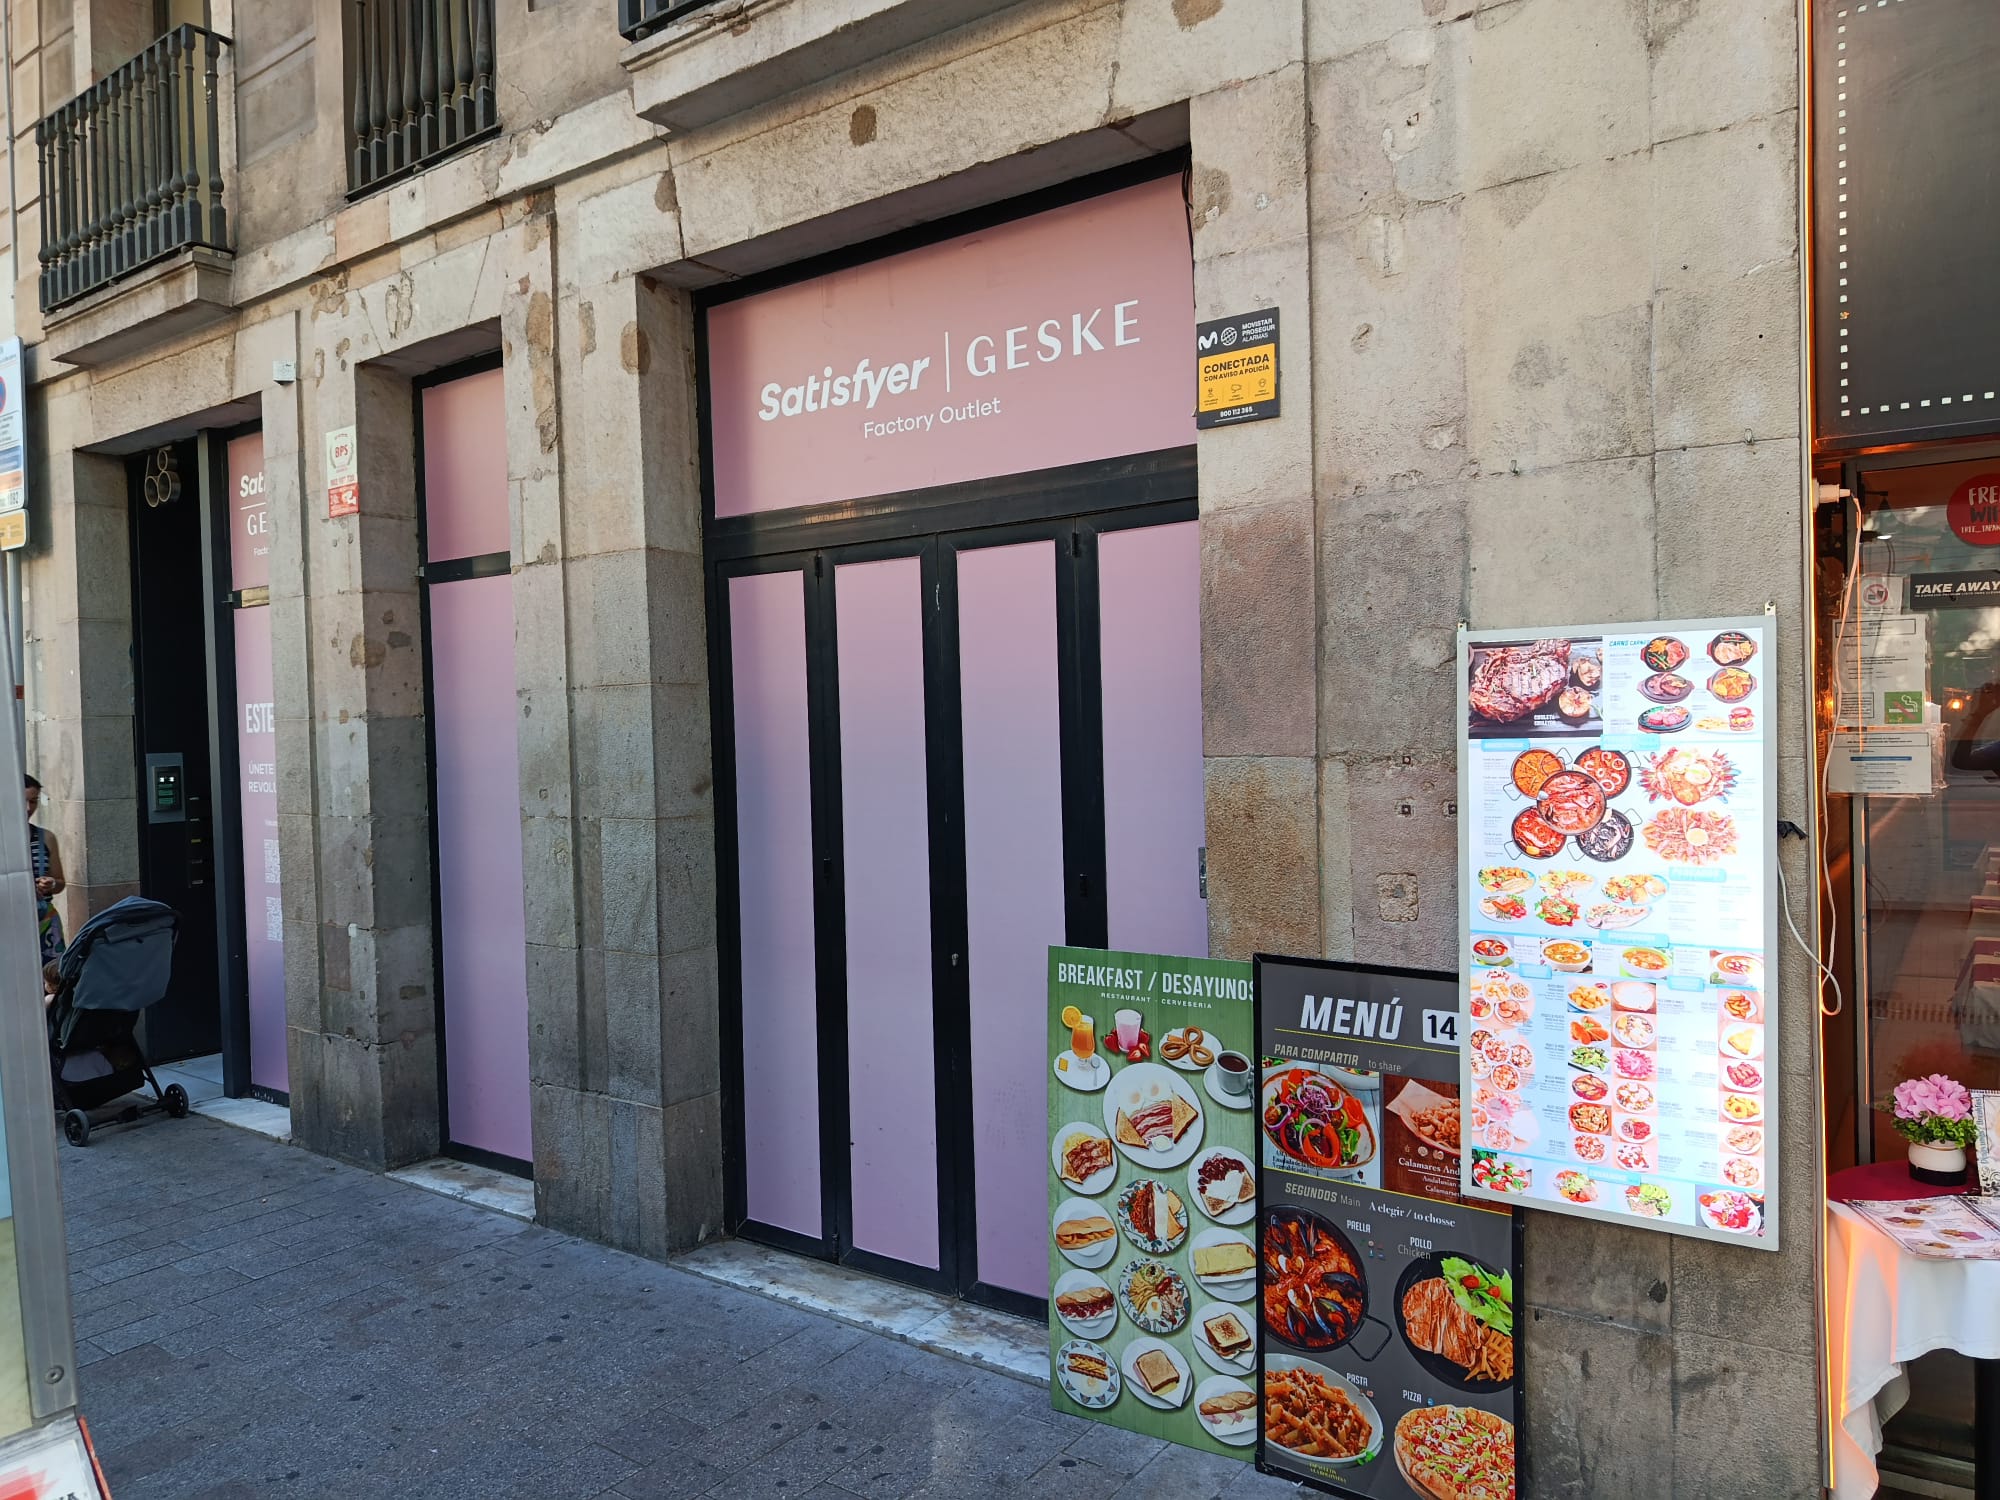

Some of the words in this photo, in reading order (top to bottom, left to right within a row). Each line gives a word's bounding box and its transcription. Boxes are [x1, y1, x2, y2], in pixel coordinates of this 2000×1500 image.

[1241, 318, 1273, 330] MOVISTAR
[1241, 324, 1276, 336] PROSEGUR
[1241, 332, 1269, 342] ALARMAS
[758, 357, 931, 421] Satisfyer
[966, 299, 1141, 377] GESKE
[1203, 353, 1270, 375] CONECTADA
[1203, 374, 1218, 383] CON
[1218, 370, 1238, 380] AVISO
[1238, 367, 1244, 375] A
[1244, 363, 1270, 374] POLICÍA
[863, 412, 934, 439] Factory
[939, 397, 1002, 425] Outlet
[335, 444, 349, 459] BPS
[1968, 485, 2000, 506] FRE
[1914, 583, 1953, 595] TAKE
[1955, 580, 2000, 594] AWAY
[245, 702, 275, 734] ESTE
[248, 760, 275, 775] ÚNETE
[1058, 962, 1144, 991] BREAKFAST
[1147, 971, 1157, 991] /
[1101, 992, 1151, 1003] RESTAURANT
[1161, 998, 1212, 1010] CERVESERIA
[1300, 994, 1403, 1041] MENÚ
[1427, 1014, 1458, 1041] 14
[1274, 1043, 1299, 1058] PARA
[1300, 1047, 1359, 1067] COMPARTIR
[1368, 1059, 1377, 1069] to
[1378, 1060, 1402, 1073] share
[1398, 1157, 1441, 1172] Calamares
[1285, 1182, 1338, 1202] SEGUNDOS
[1340, 1194, 1361, 1208] Main
[1368, 1201, 1377, 1212] A
[1377, 1203, 1405, 1218] elegir
[1413, 1212, 1423, 1221] to
[1424, 1213, 1456, 1228] chosse
[1346, 1219, 1371, 1233] PAELLA
[1410, 1236, 1432, 1250] POLLO
[1397, 1244, 1431, 1260] Chicken
[1346, 1372, 1368, 1387] PASTA
[1402, 1389, 1422, 1404] PIZZA
